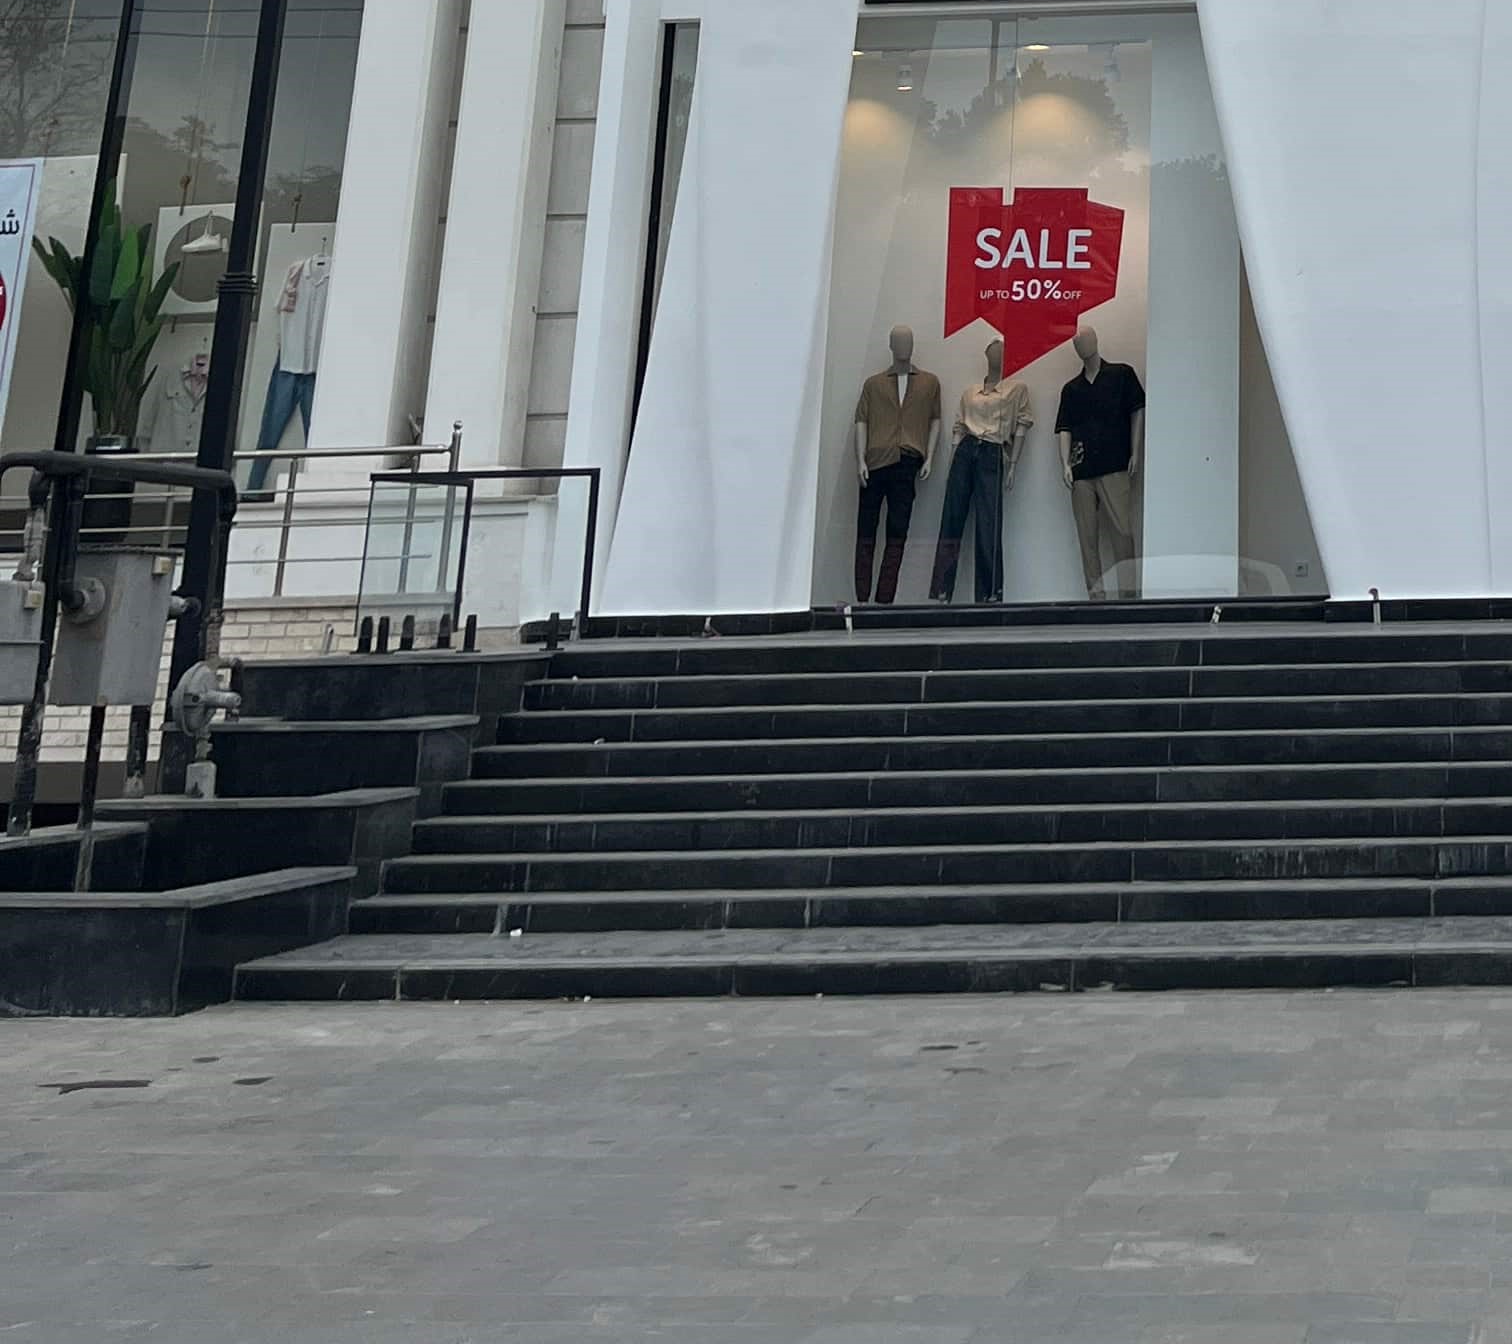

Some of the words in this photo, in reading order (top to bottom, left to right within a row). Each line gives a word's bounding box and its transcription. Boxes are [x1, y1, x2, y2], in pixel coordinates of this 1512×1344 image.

[974, 227, 1093, 269] SALE
[980, 290, 994, 300] UP
[996, 290, 1010, 300] TO
[1011, 279, 1062, 301] 50%
[1062, 291, 1082, 300] OFF
